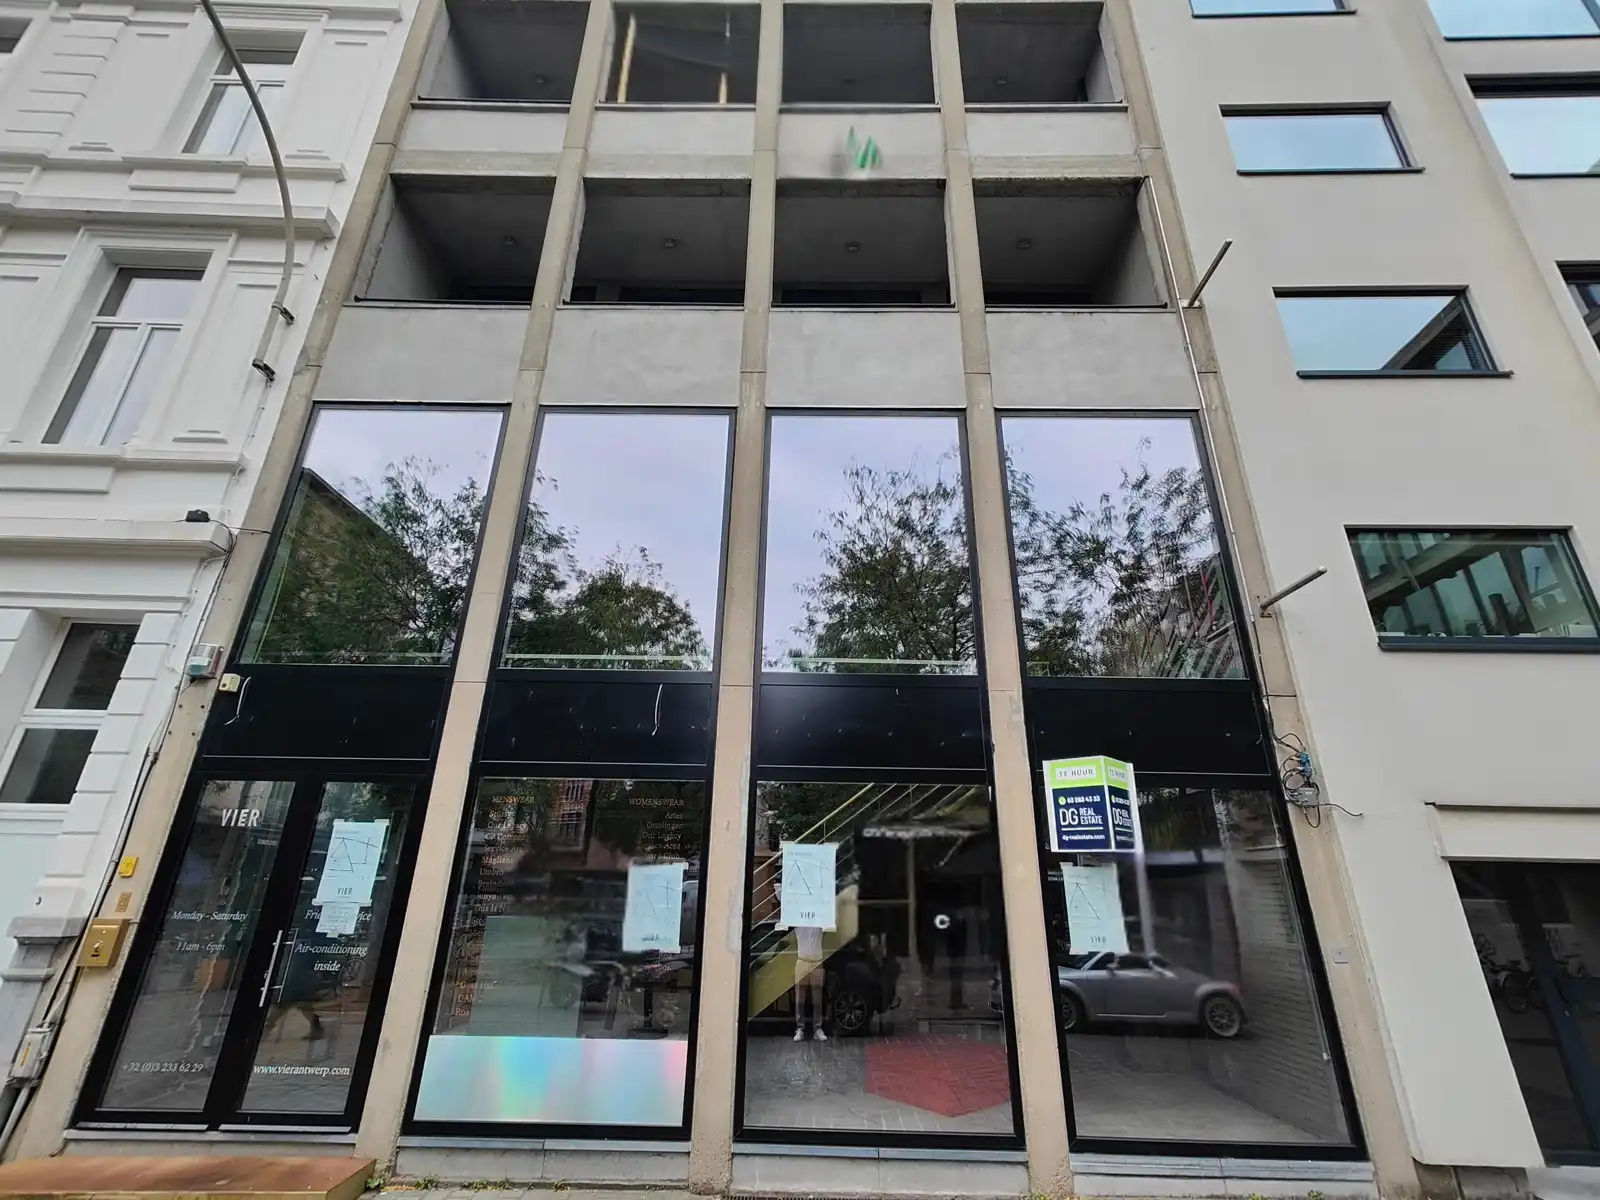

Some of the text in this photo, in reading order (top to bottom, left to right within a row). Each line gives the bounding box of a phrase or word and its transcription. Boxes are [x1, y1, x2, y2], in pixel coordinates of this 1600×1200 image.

[1071, 769, 1094, 777] HUUR
[491, 795, 536, 805] MENSWEAR
[628, 797, 686, 806] WOMENSWEAR
[1059, 808, 1079, 826] DG
[1079, 807, 1096, 816] REAL
[220, 808, 262, 829] VIER
[1080, 815, 1104, 825] ESTATE
[657, 830, 682, 842] Legacy
[480, 866, 505, 876] Umbro
[337, 887, 353, 896] VIER
[171, 910, 205, 922] Monday
[210, 910, 248, 924] Saturday
[295, 943, 367, 957] Air-conditioning
[314, 961, 341, 973] inside
[160, 1062, 179, 1073] 233
[179, 1062, 191, 1073] 62
[191, 1062, 204, 1073] 29
[253, 1064, 351, 1077] www.vierantwerp.com
